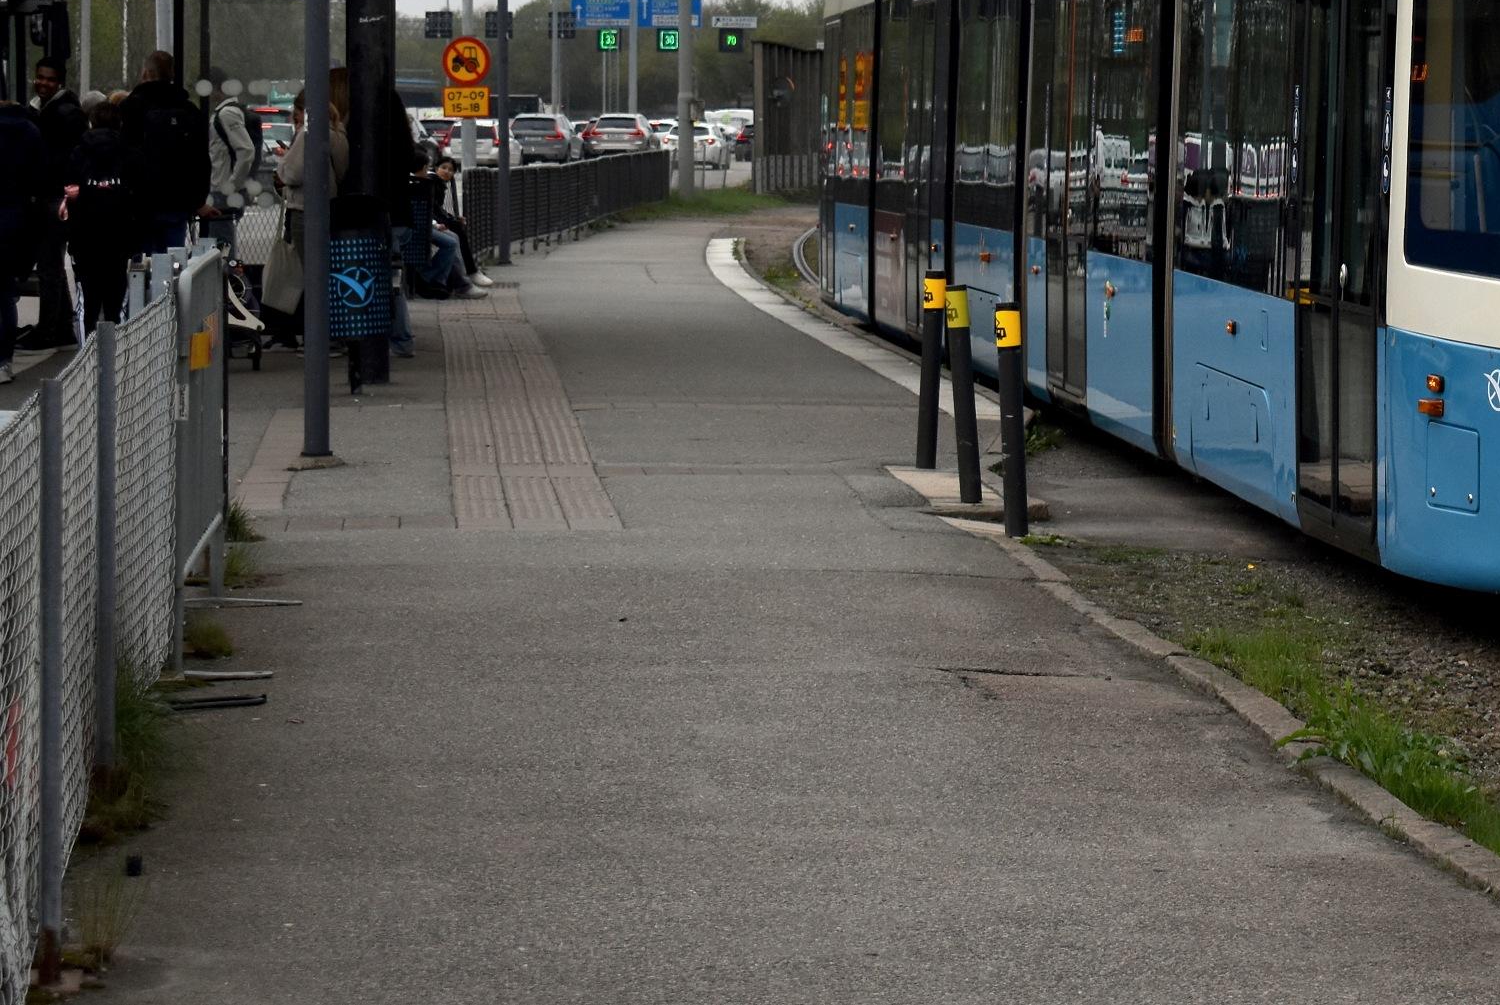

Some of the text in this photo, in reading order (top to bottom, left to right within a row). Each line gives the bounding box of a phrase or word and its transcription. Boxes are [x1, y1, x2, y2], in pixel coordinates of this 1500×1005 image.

[664, 34, 675, 45] 30
[727, 34, 737, 46] 70
[447, 91, 485, 101] 07-09
[452, 102, 480, 113] 15-18
